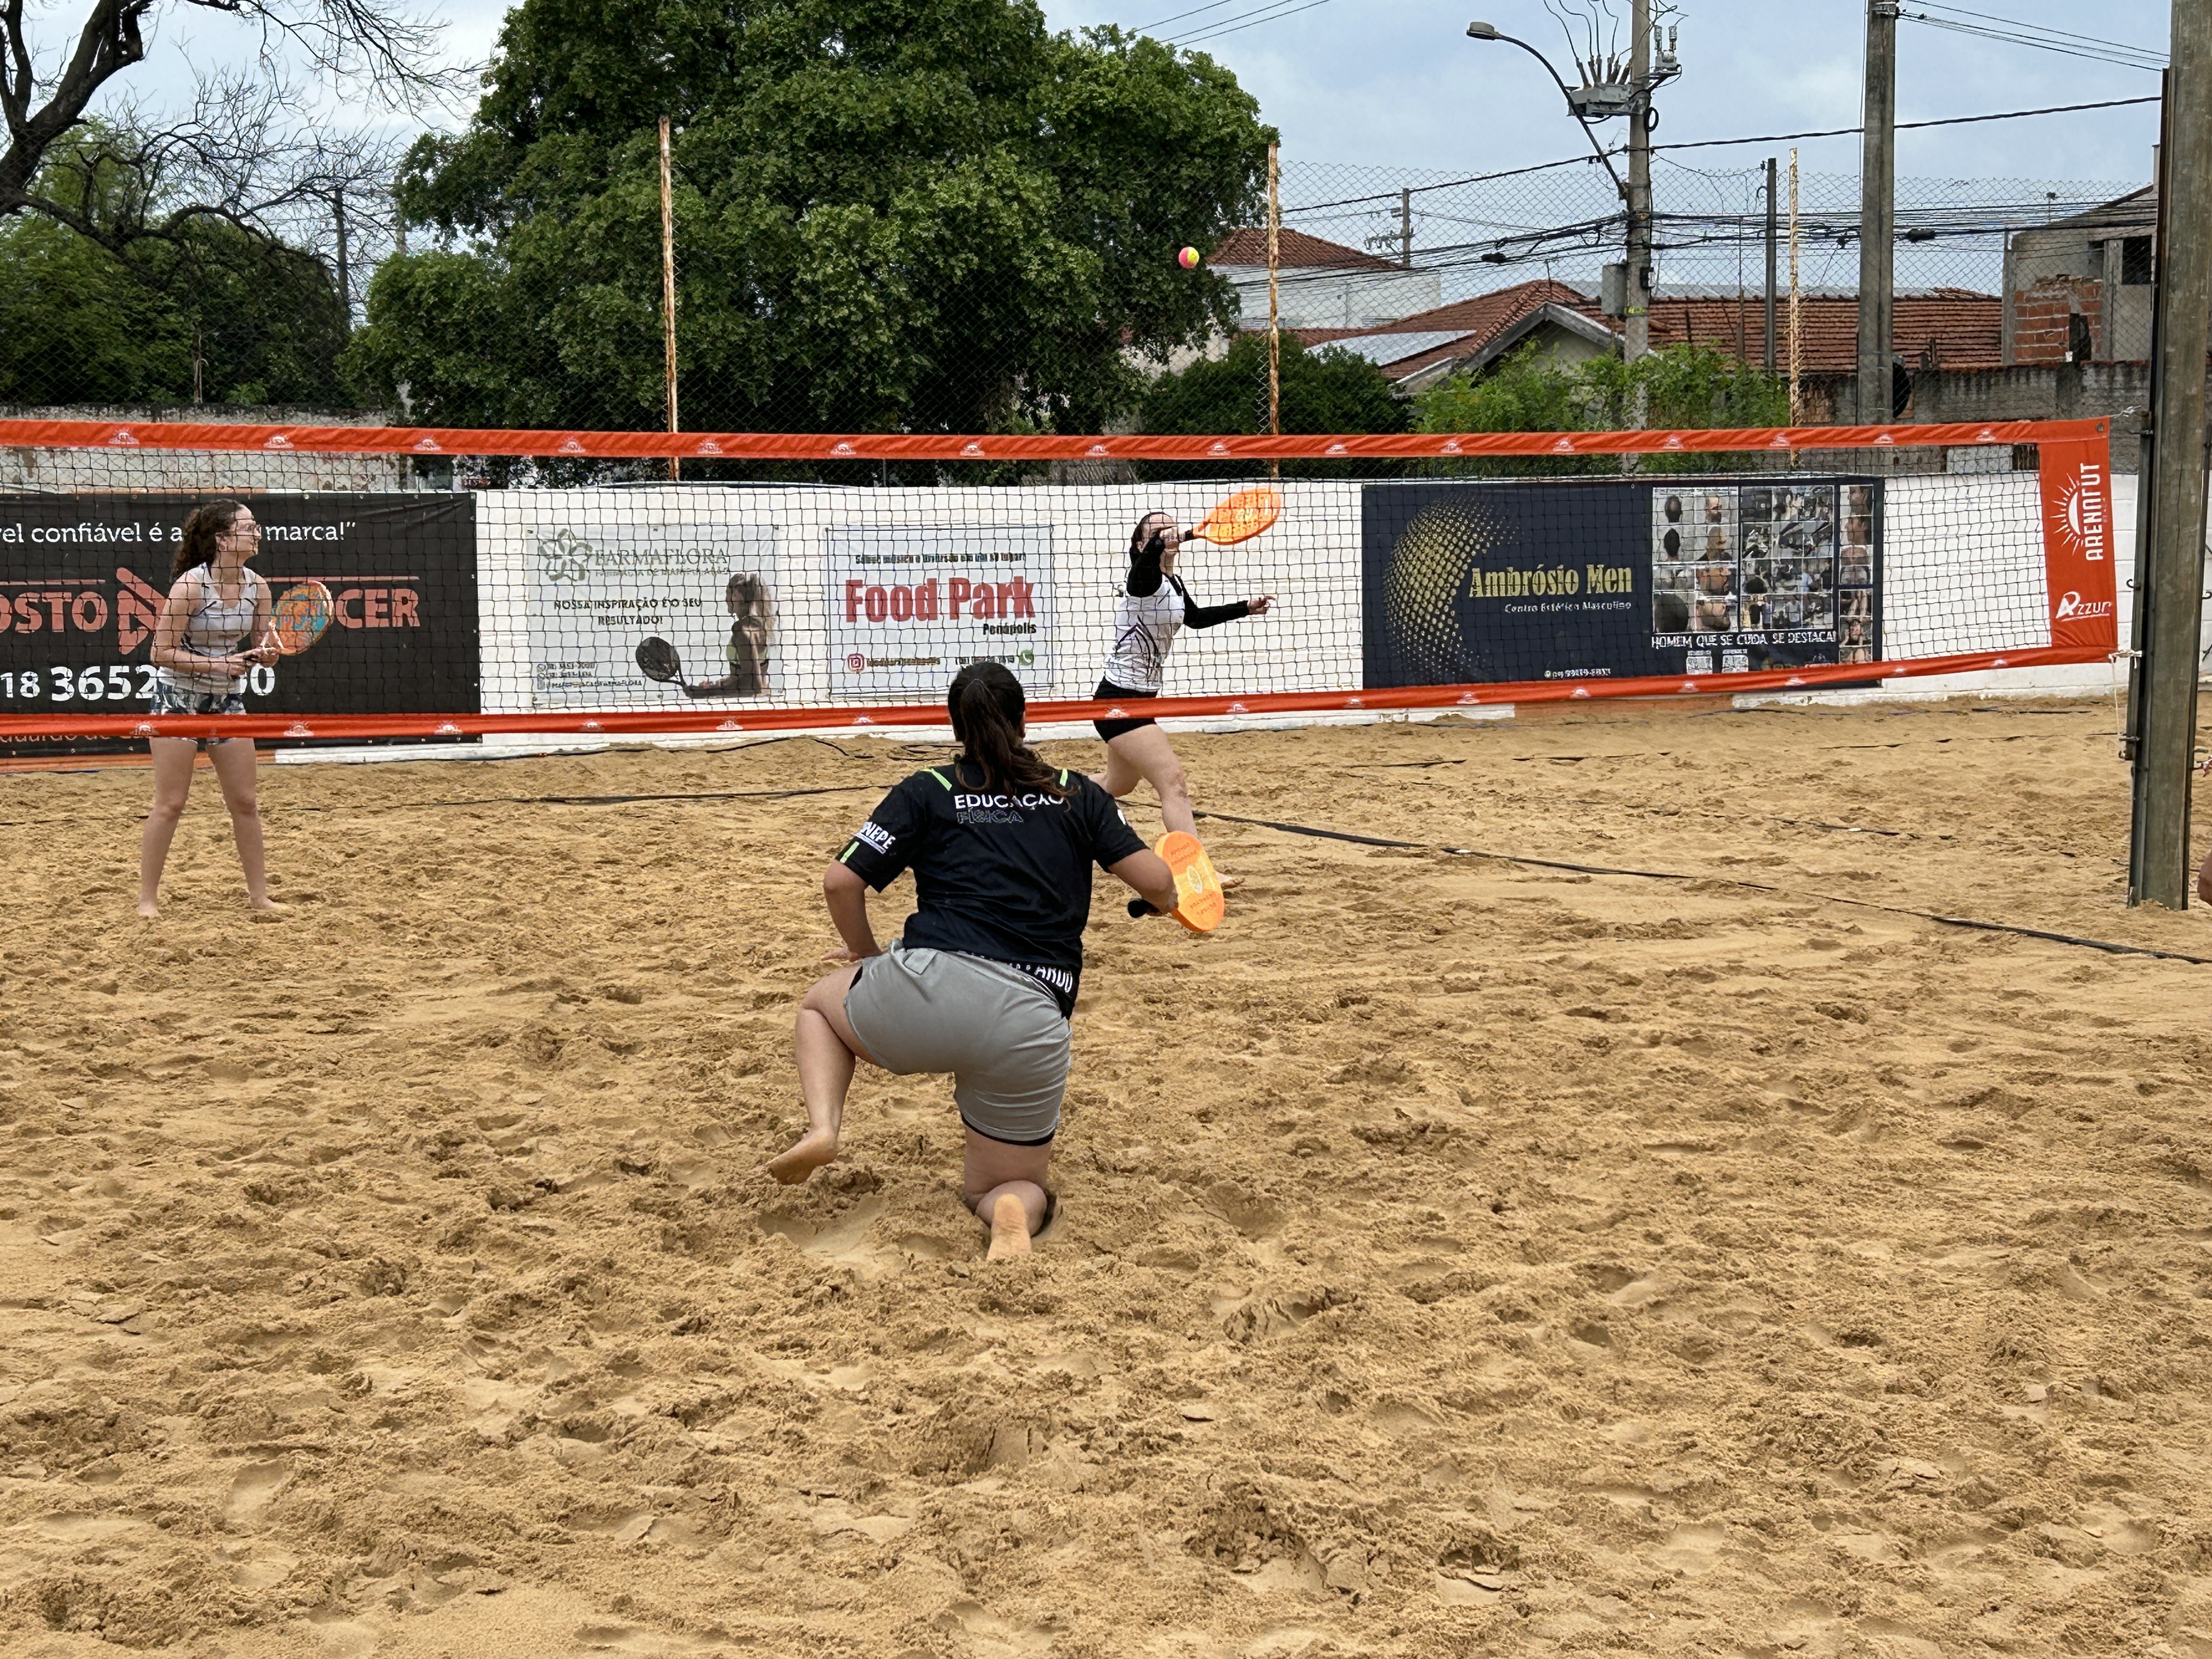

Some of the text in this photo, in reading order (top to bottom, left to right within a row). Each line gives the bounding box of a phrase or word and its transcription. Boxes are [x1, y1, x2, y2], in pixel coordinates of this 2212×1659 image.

[0, 523, 24, 543] el
[31, 522, 142, 543] confiável
[149, 522, 162, 541] é
[595, 549, 728, 566] FARMAFLORA
[1469, 563, 1632, 597] Ambrósio Men
[595, 597, 658, 611] INSPIRAÇÃO
[845, 576, 1036, 623] Food Park
[0, 591, 108, 634] STO
[983, 623, 1037, 635] Penápolis
[1651, 635, 1692, 648] HOMEM
[1696, 634, 1717, 647] QUE
[1720, 634, 1734, 645] SE
[1772, 633, 1785, 644] SE
